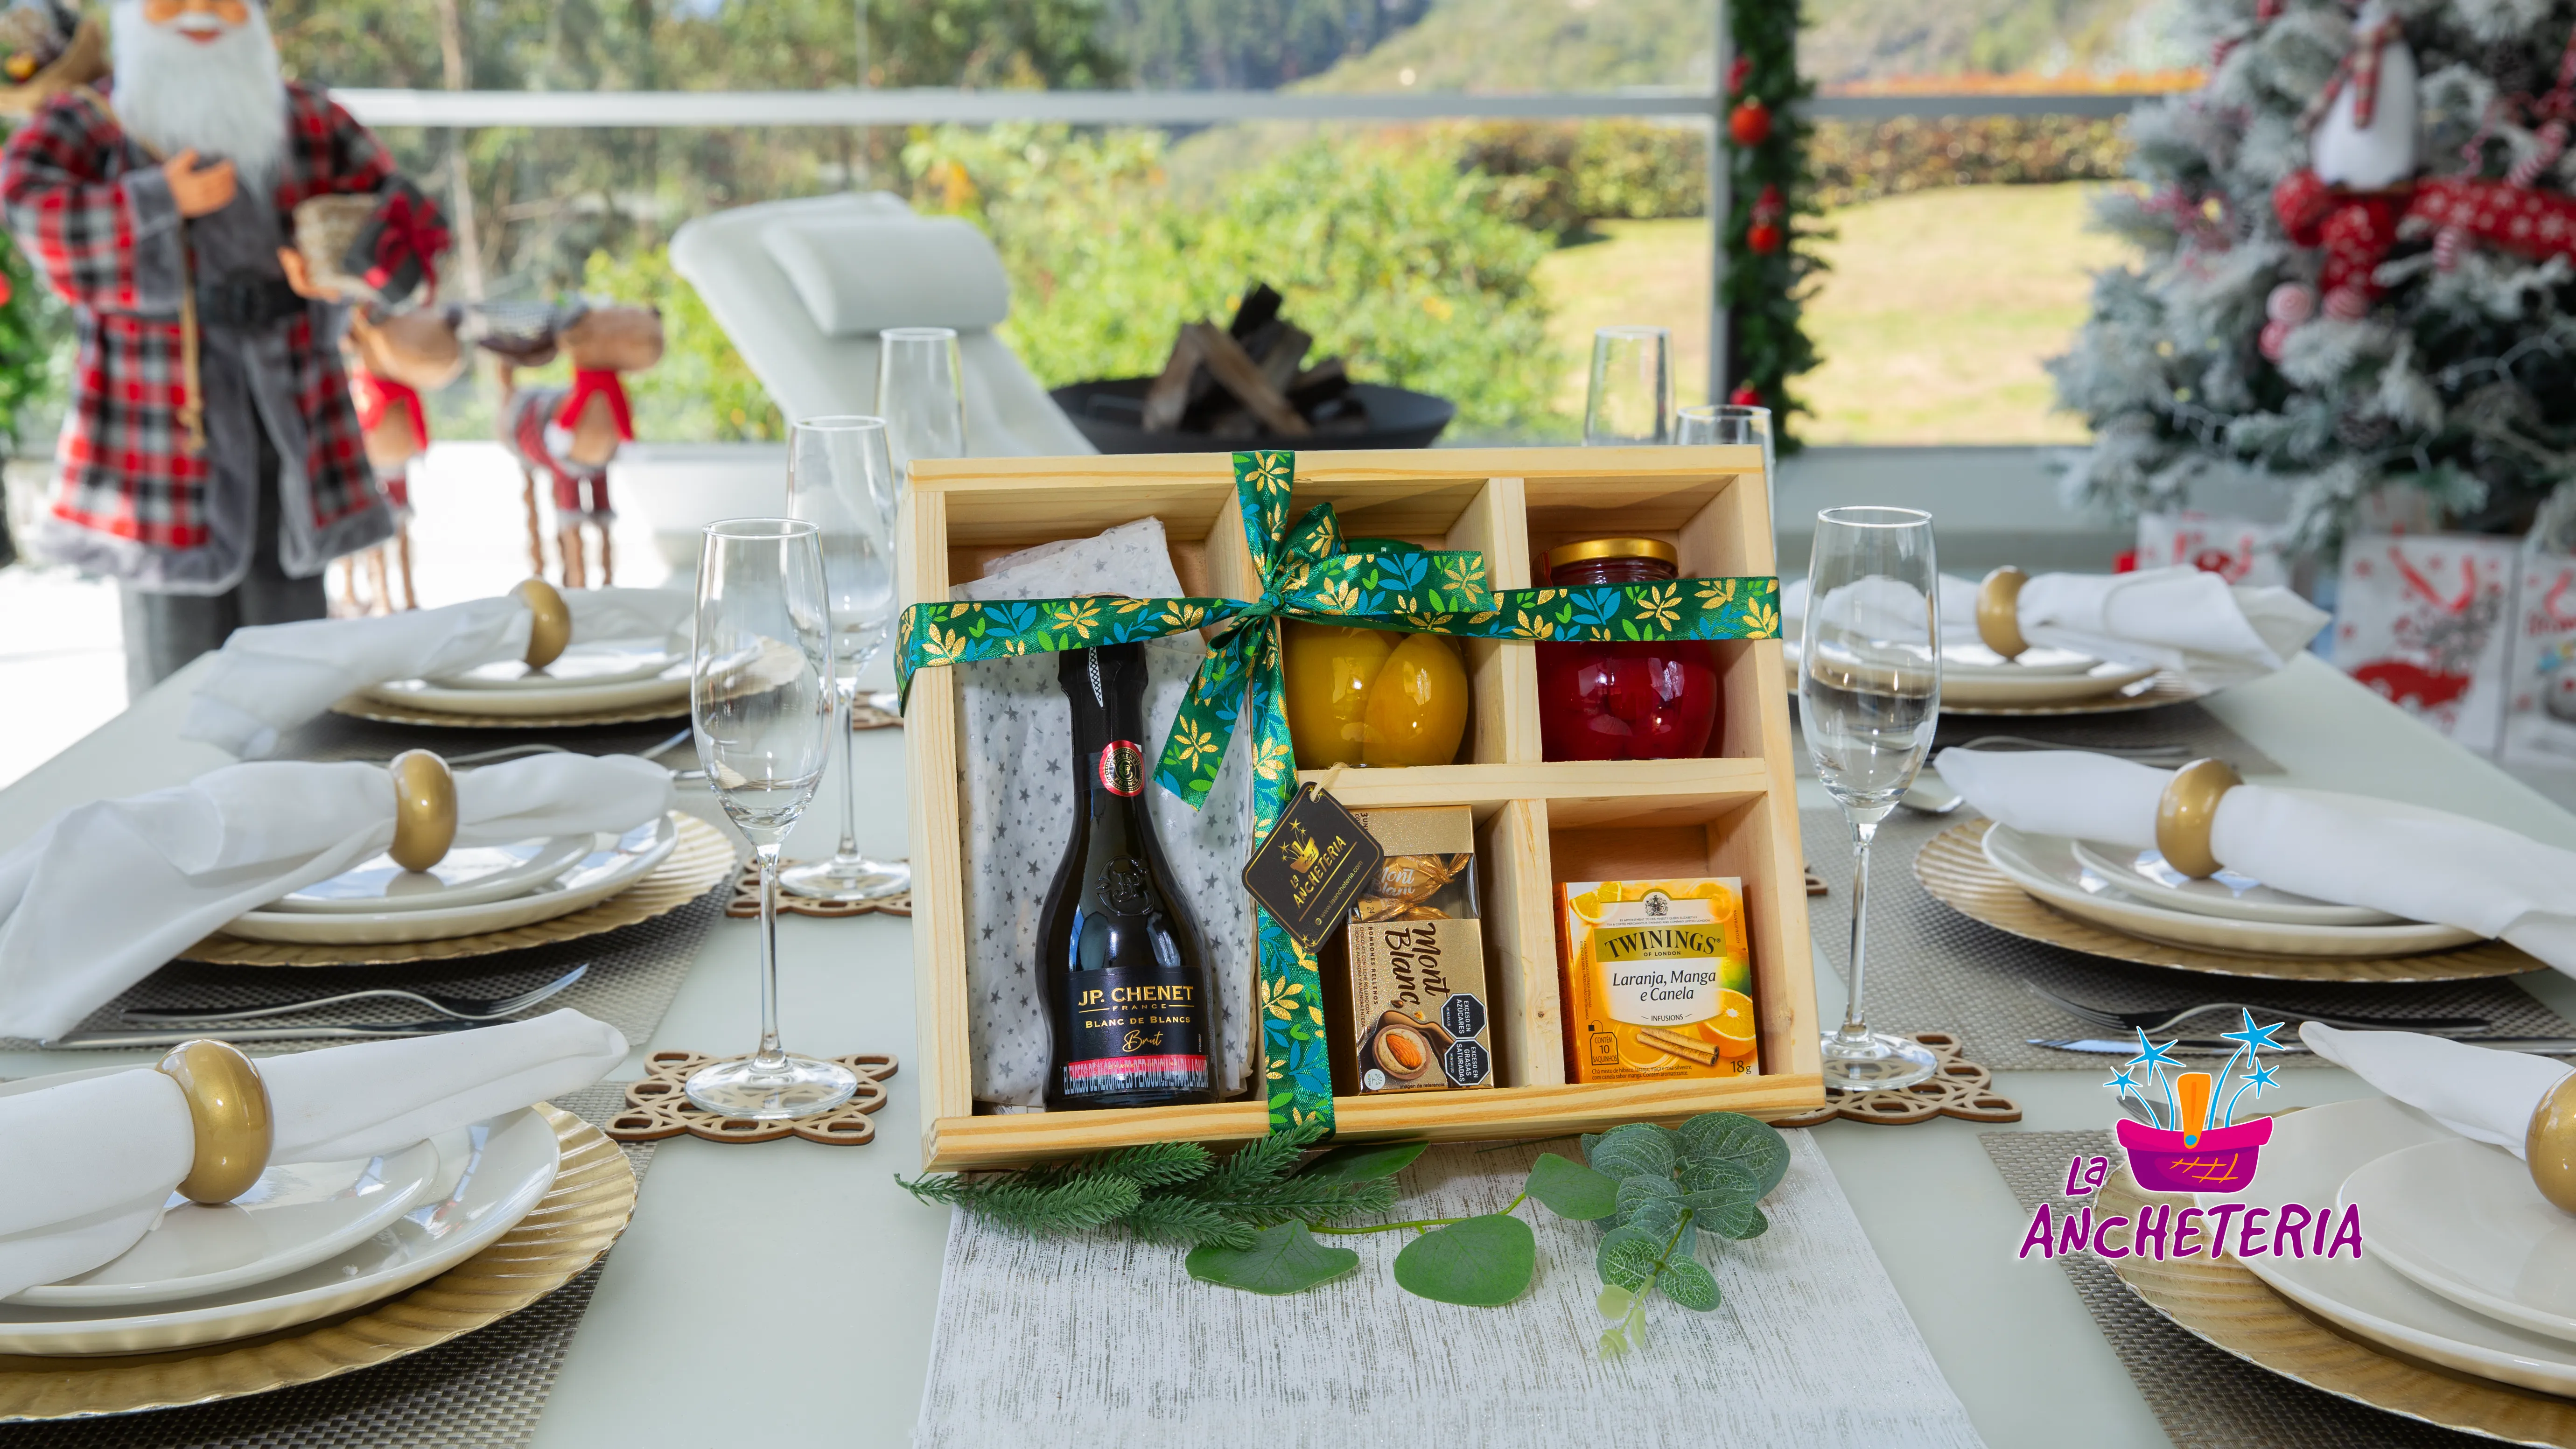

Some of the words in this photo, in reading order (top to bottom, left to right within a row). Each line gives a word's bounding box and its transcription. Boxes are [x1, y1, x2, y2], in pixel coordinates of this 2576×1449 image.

[1290, 875, 1299, 889] La
[1293, 835, 1346, 909] ANCHETERIA
[1320, 861, 1363, 918] www.laancheteria.com
[1385, 927, 1421, 1005] Blanc
[1412, 922, 1450, 999] Mont
[1613, 971, 1666, 987] Laranja,
[1671, 970, 1716, 985] Manga
[1078, 989, 1105, 1006] JP.
[1111, 985, 1194, 1002] CHENET
[1640, 991, 1647, 1001] e
[1651, 987, 1694, 1001] Canela
[1085, 1019, 1125, 1029] BLANC
[1456, 999, 1465, 1034] AZÚCARES
[1465, 1023, 1471, 1032] EN
[1122, 1029, 1163, 1052] Brut
[1595, 1035, 1612, 1043] CONTÉM
[1599, 1045, 1610, 1054] 10
[1456, 1043, 1465, 1082] SATURADAS
[1593, 1055, 1617, 1064] SAQUINHOS
[1064, 1066, 1070, 1095] EL
[1070, 1064, 1089, 1094] EXCESO
[1089, 1063, 1097, 1092] DE
[1125, 1060, 1133, 1089] ES
[1134, 1058, 1174, 1088] PERJUDICIAL
[1190, 1058, 1196, 1087] LA
[1196, 1059, 1209, 1088] SALUD
